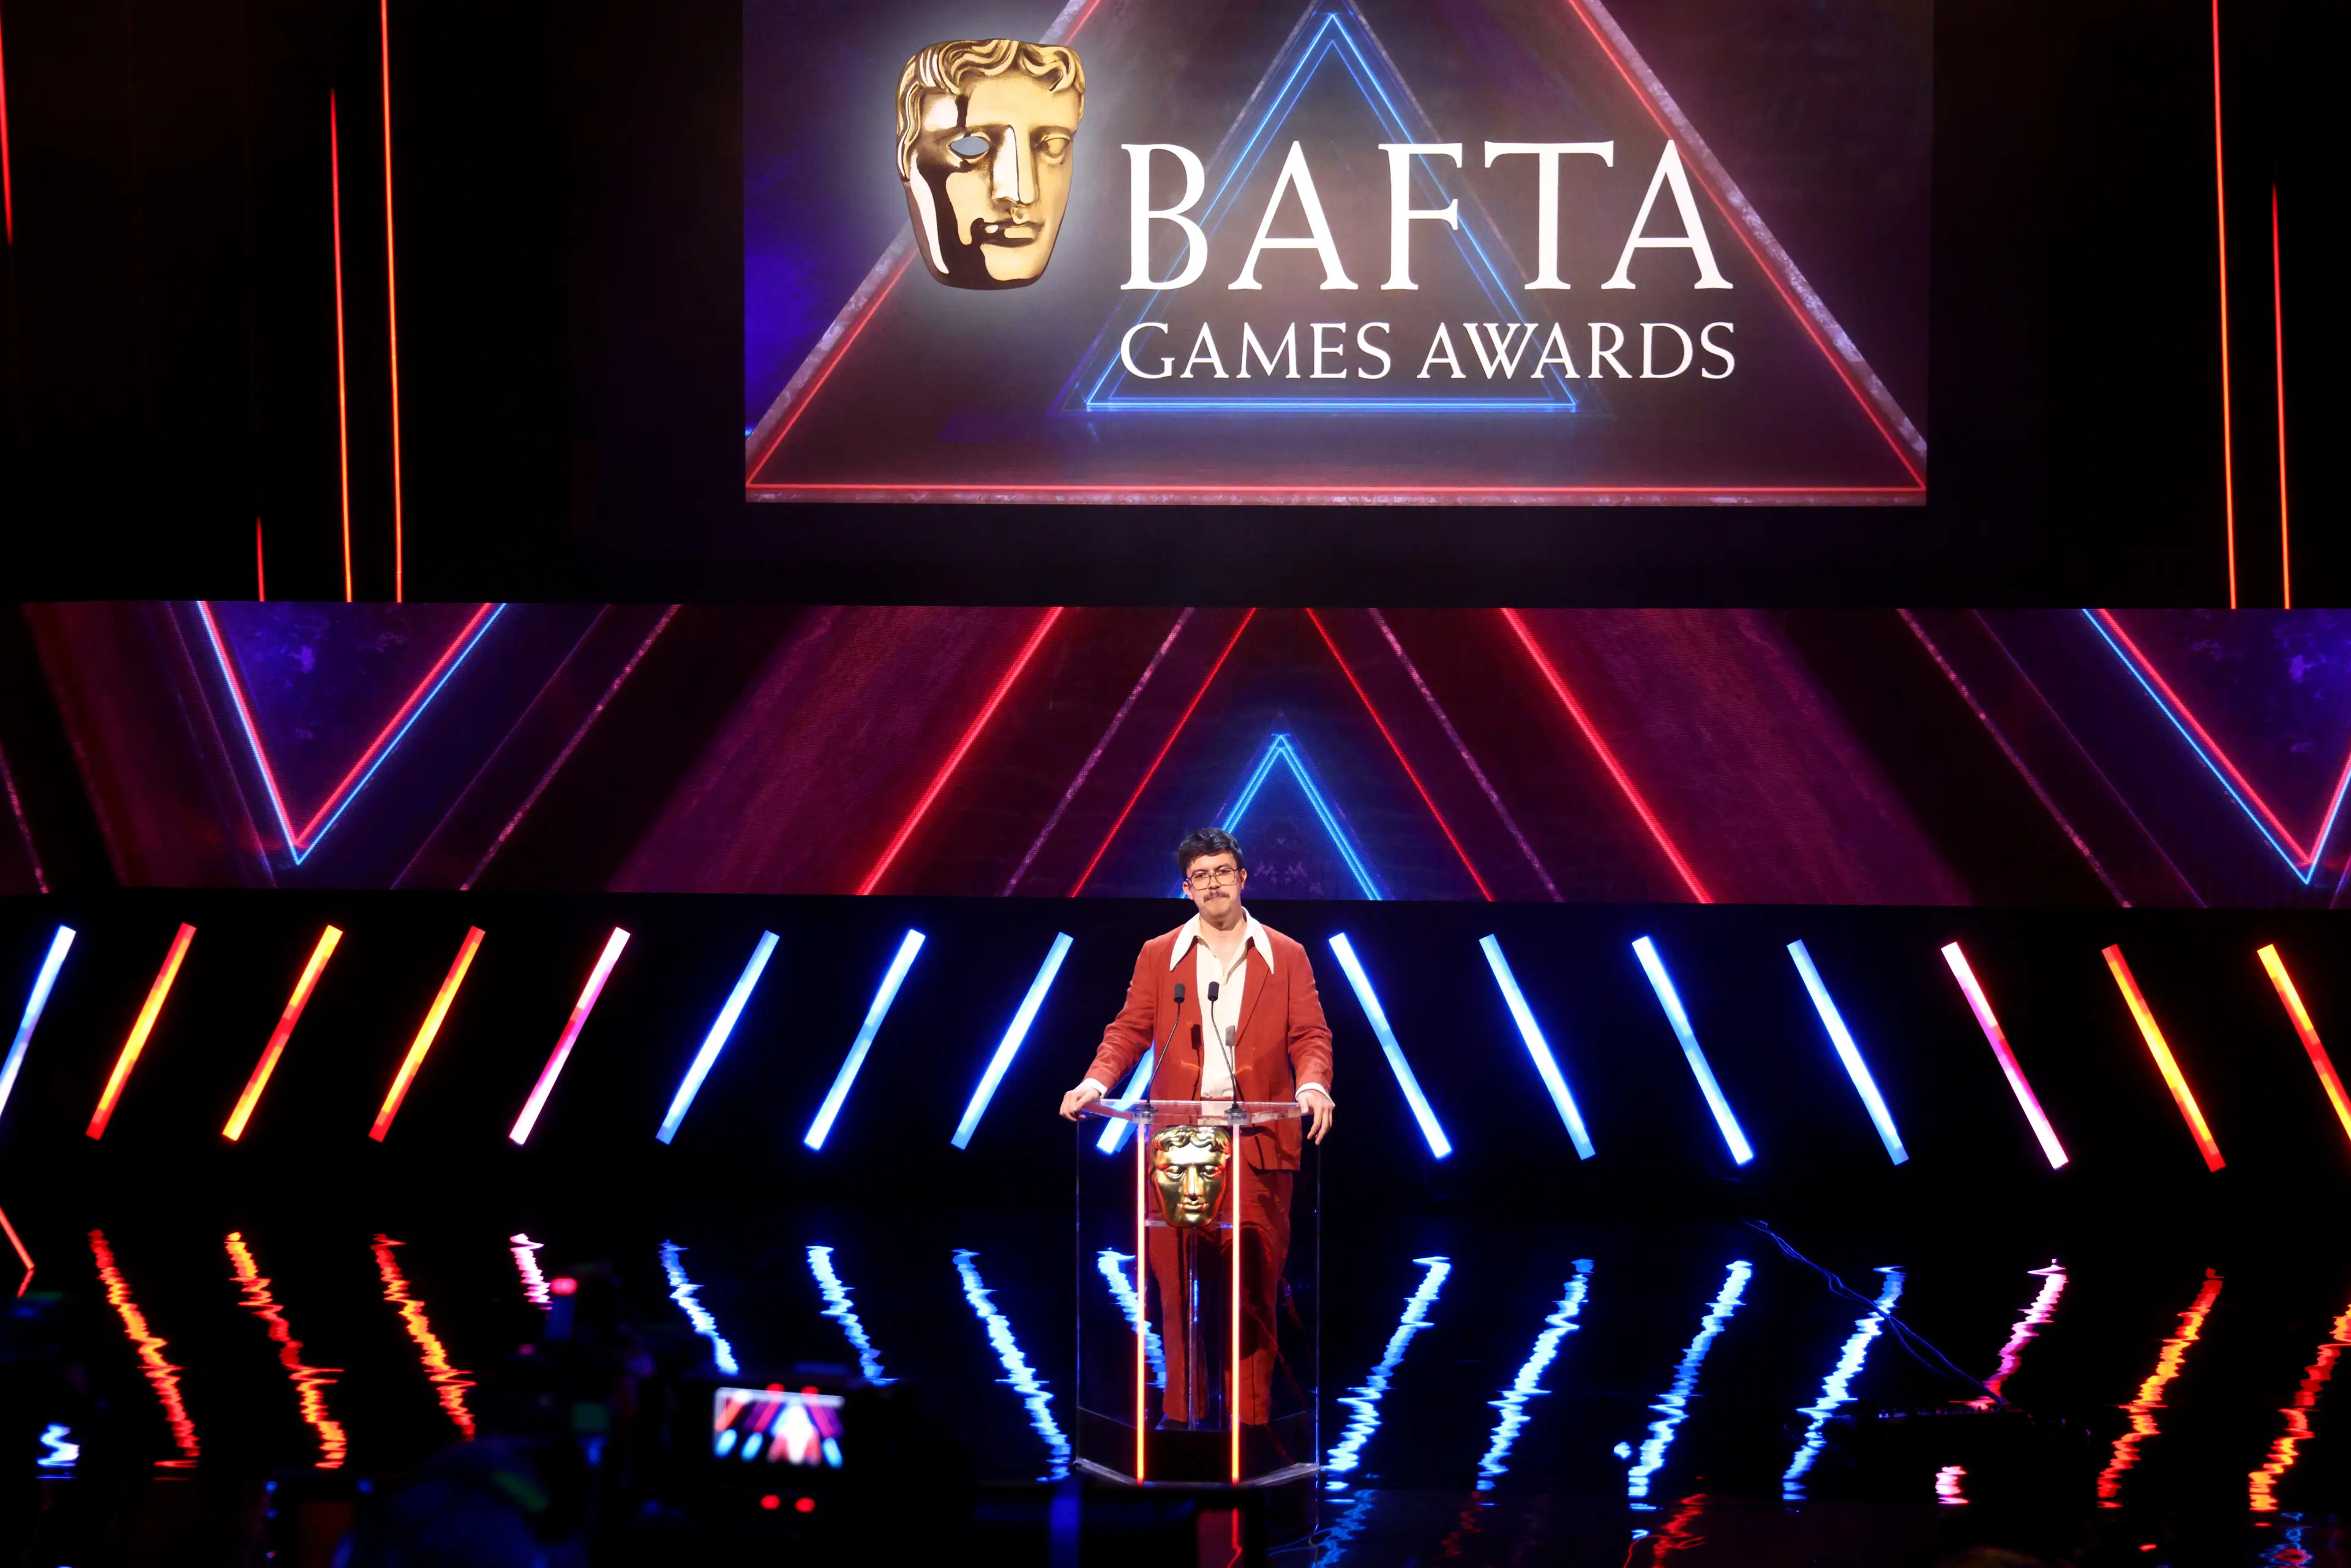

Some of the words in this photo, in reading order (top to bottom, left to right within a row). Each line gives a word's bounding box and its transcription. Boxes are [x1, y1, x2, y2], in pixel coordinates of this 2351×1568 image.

[1121, 140, 1733, 290] BAFTA
[1121, 323, 1390, 378] GAMES
[1417, 323, 1734, 379] AWARDS
